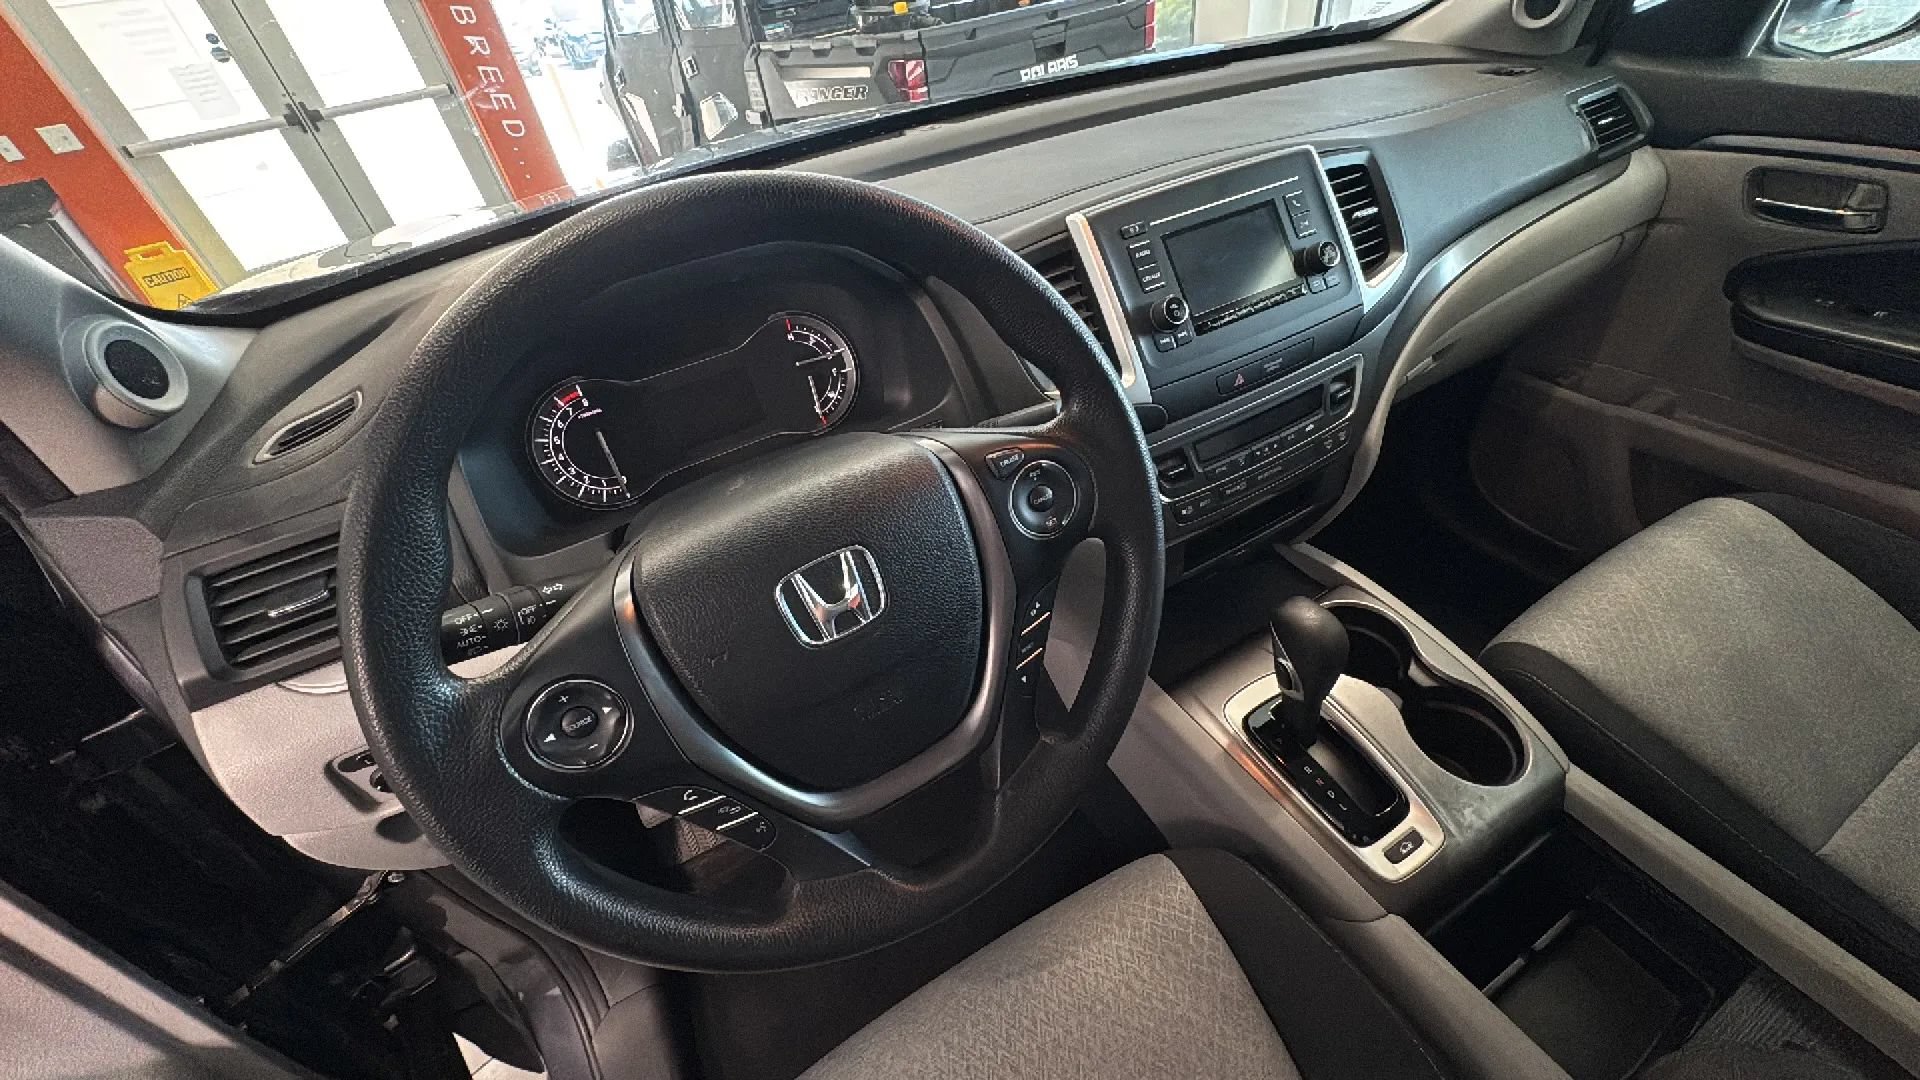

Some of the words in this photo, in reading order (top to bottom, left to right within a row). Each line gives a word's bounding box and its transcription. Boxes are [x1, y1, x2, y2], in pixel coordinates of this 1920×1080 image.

[1020, 54, 1079, 82] POLARIS
[143, 267, 190, 288] CAUTION
[582, 398, 589, 407] 8
[566, 408, 573, 417] 7
[558, 420, 565, 429] 6
[553, 436, 560, 445] 5
[558, 453, 565, 461] 4
[1000, 454, 1019, 467] CRUISE
[568, 466, 577, 476] 3
[583, 475, 591, 485] 2
[521, 604, 537, 616] OFF
[454, 614, 473, 625] OFF
[456, 635, 482, 649] AUTO
[1327, 790, 1335, 799] D
